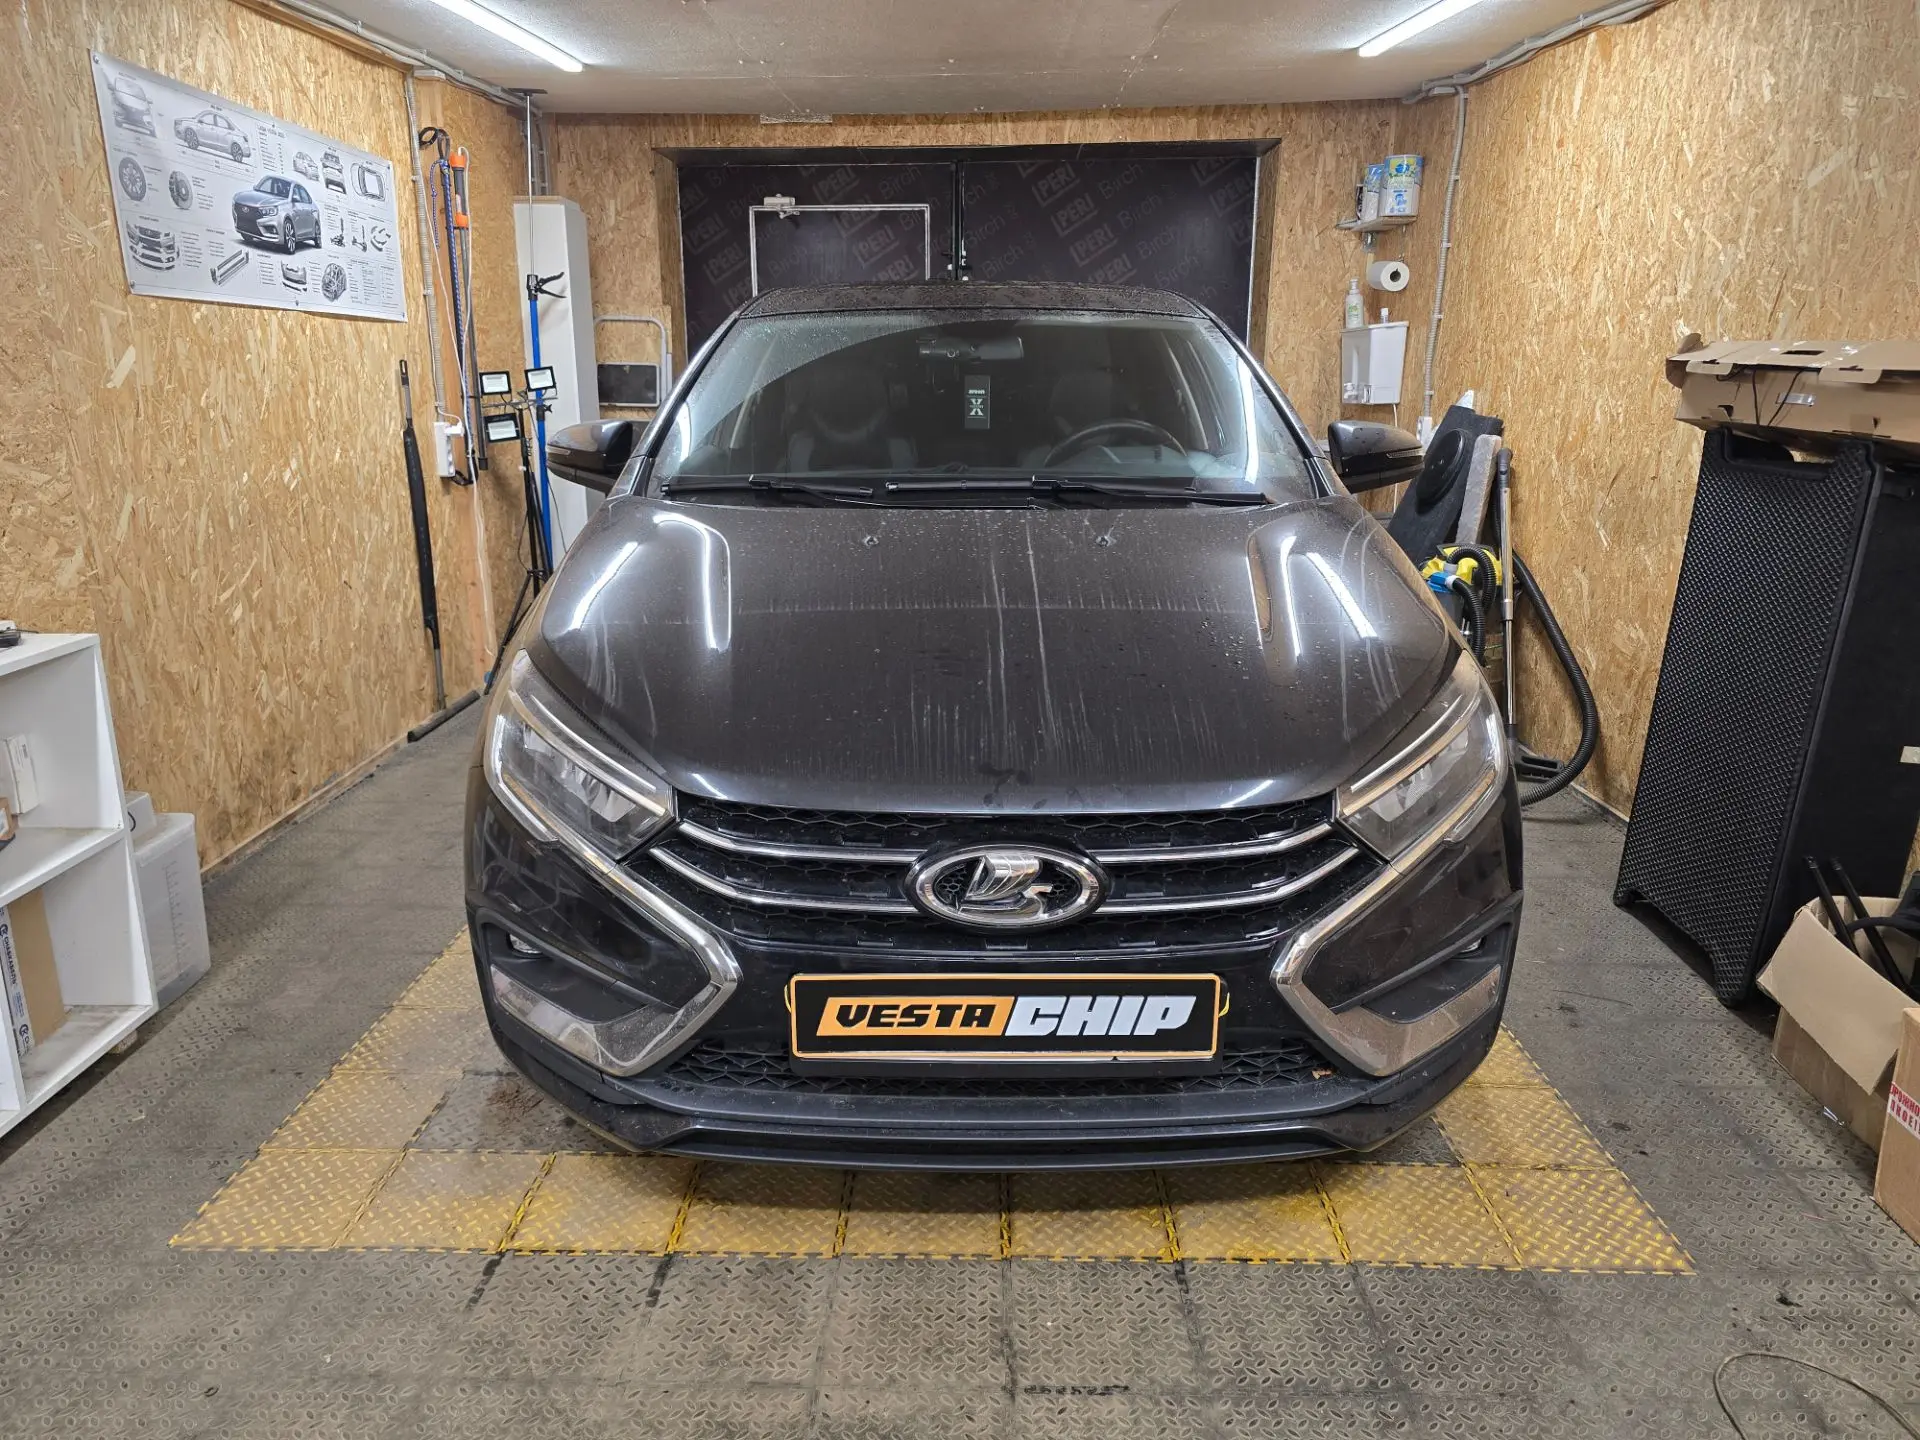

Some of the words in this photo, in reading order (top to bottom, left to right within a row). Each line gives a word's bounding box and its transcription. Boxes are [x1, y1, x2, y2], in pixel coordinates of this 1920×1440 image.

[878, 165, 922, 200] Birch
[1036, 162, 1076, 198] PERI
[1056, 193, 1095, 228] PERI
[1098, 162, 1143, 200] Birch
[689, 211, 726, 246] PERI
[859, 224, 897, 258] PERI
[1075, 223, 1114, 258] PERI
[1117, 192, 1162, 229] Birch
[708, 241, 746, 277] PERI
[981, 244, 1025, 279] Birch
[1092, 252, 1132, 284] PERI
[835, 1004, 998, 1029] VESTA
[1005, 995, 1197, 1036] CHIP
